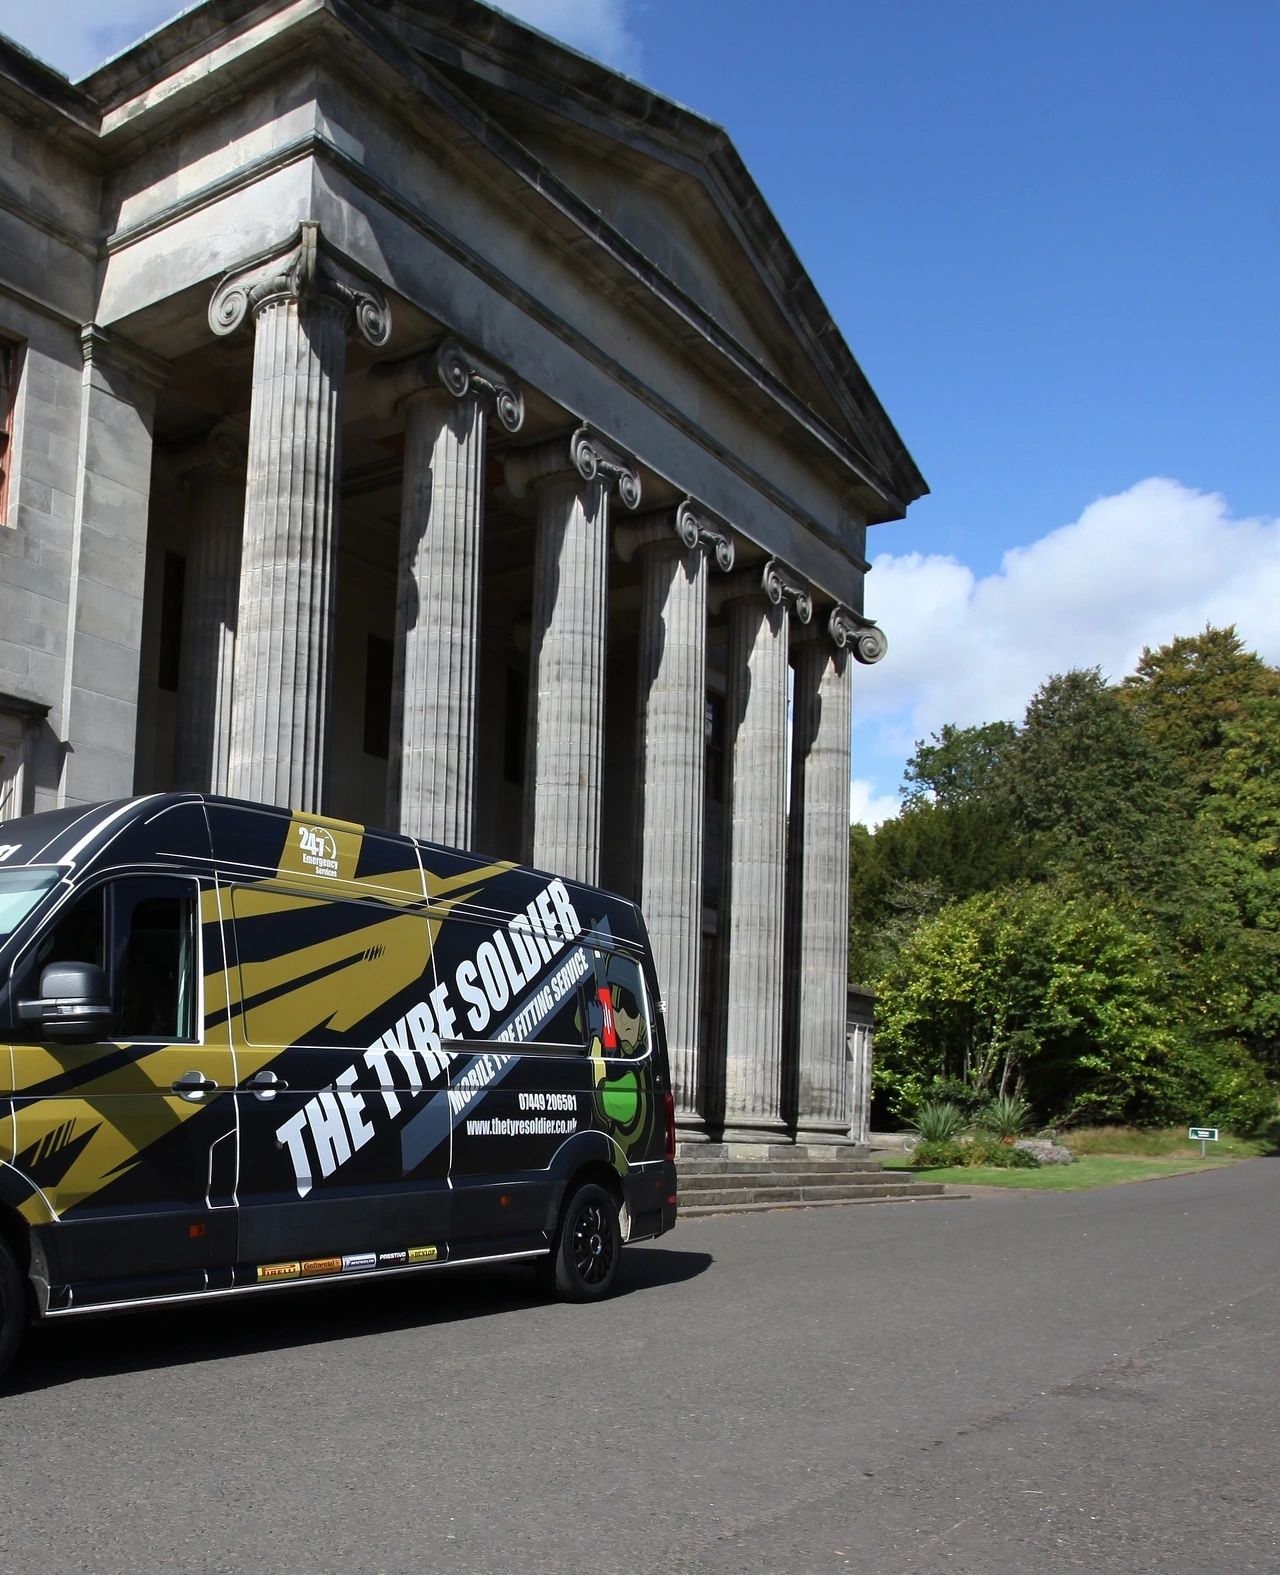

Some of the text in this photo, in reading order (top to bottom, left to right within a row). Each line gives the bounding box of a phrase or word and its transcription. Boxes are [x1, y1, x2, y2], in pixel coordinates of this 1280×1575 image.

[302, 853, 338, 870] Emergency
[316, 866, 337, 878] Services
[275, 878, 582, 1199] THE TYRE SOLDIER
[447, 1054, 496, 1115] MOBILE
[514, 985, 555, 1042] FITTING
[550, 947, 590, 1002] SERVICE
[519, 1093, 577, 1111] 07449 206581
[466, 1117, 578, 1137] www.thetyresoldier.co.uk
[414, 1249, 436, 1258] DUNLOP
[261, 1264, 296, 1277] PIRELLI
[303, 1260, 335, 1272] Continental
